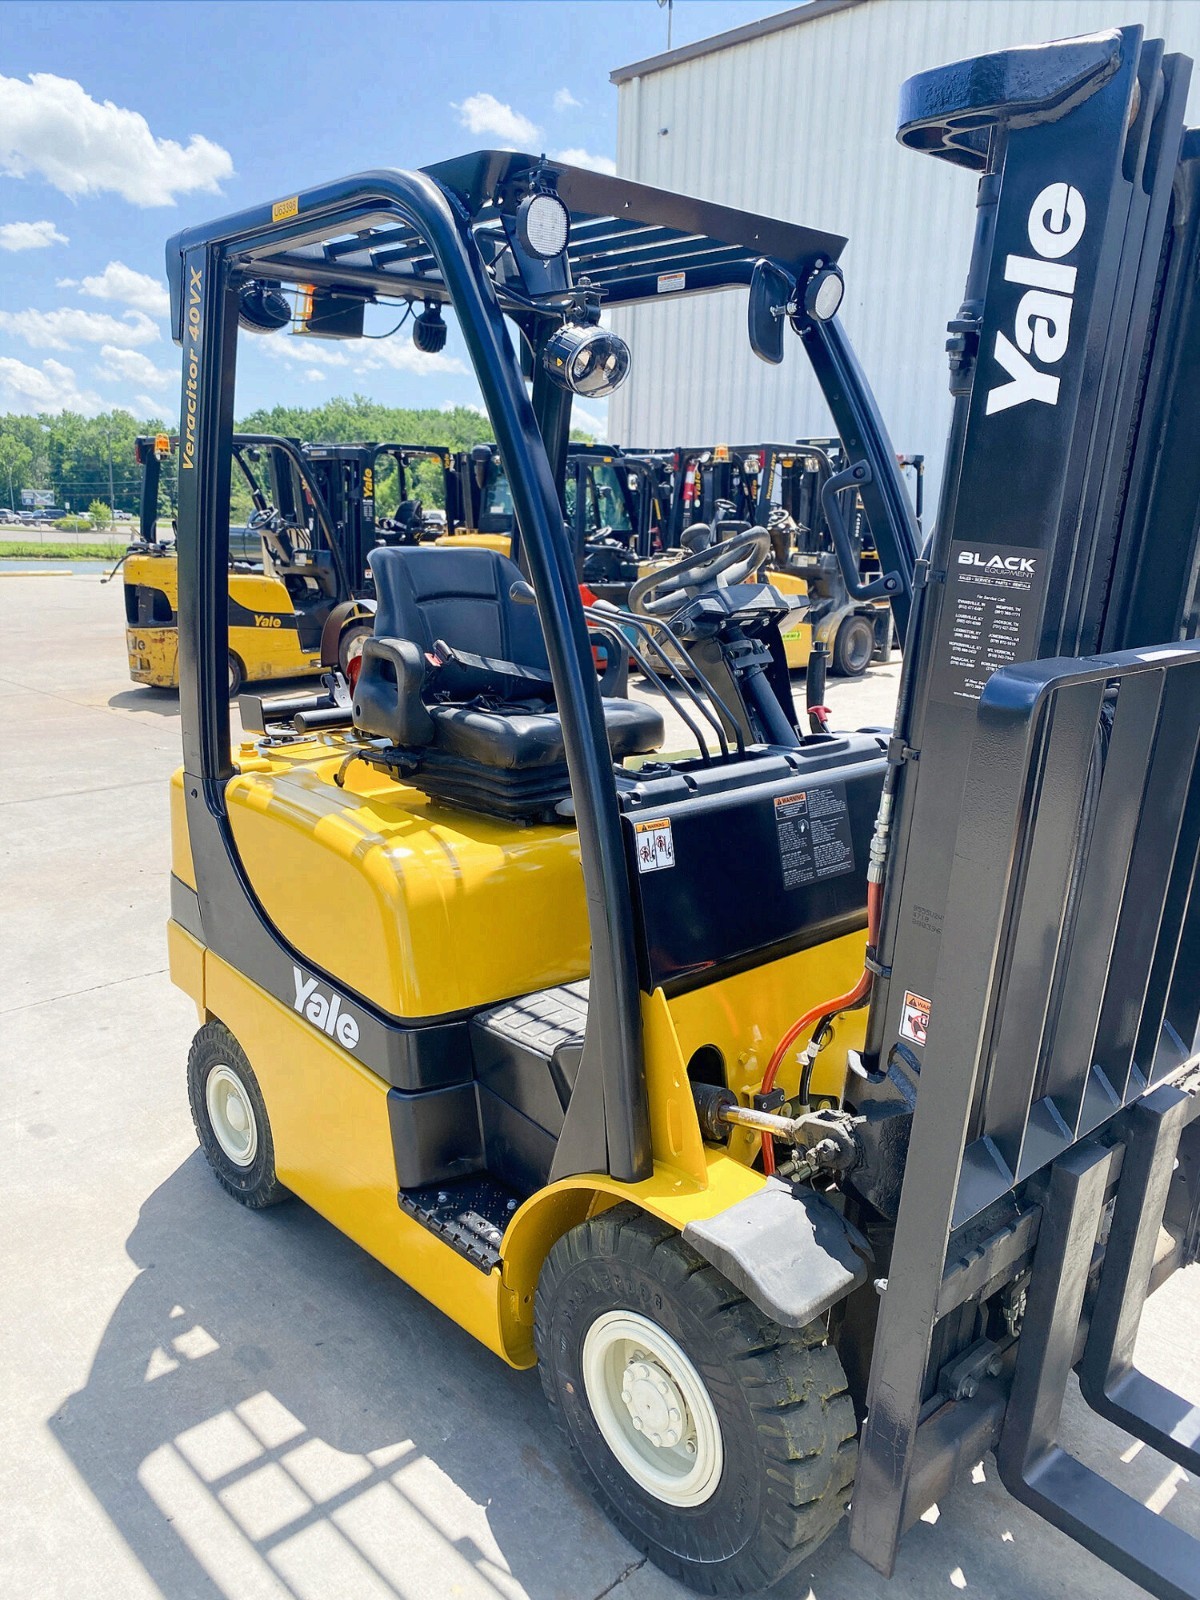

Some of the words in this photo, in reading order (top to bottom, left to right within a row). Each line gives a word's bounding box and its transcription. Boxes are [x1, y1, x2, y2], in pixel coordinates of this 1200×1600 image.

[189, 265, 203, 342] 40VX
[985, 182, 1087, 416] Yale
[182, 347, 199, 470] Veracitor
[362, 468, 373, 498] Yale
[958, 551, 1037, 572] BLACK
[984, 567, 1035, 578] EQUIPMENT
[254, 614, 282, 628] Yale
[780, 794, 805, 805] WARNING
[293, 965, 360, 1049] Yale
